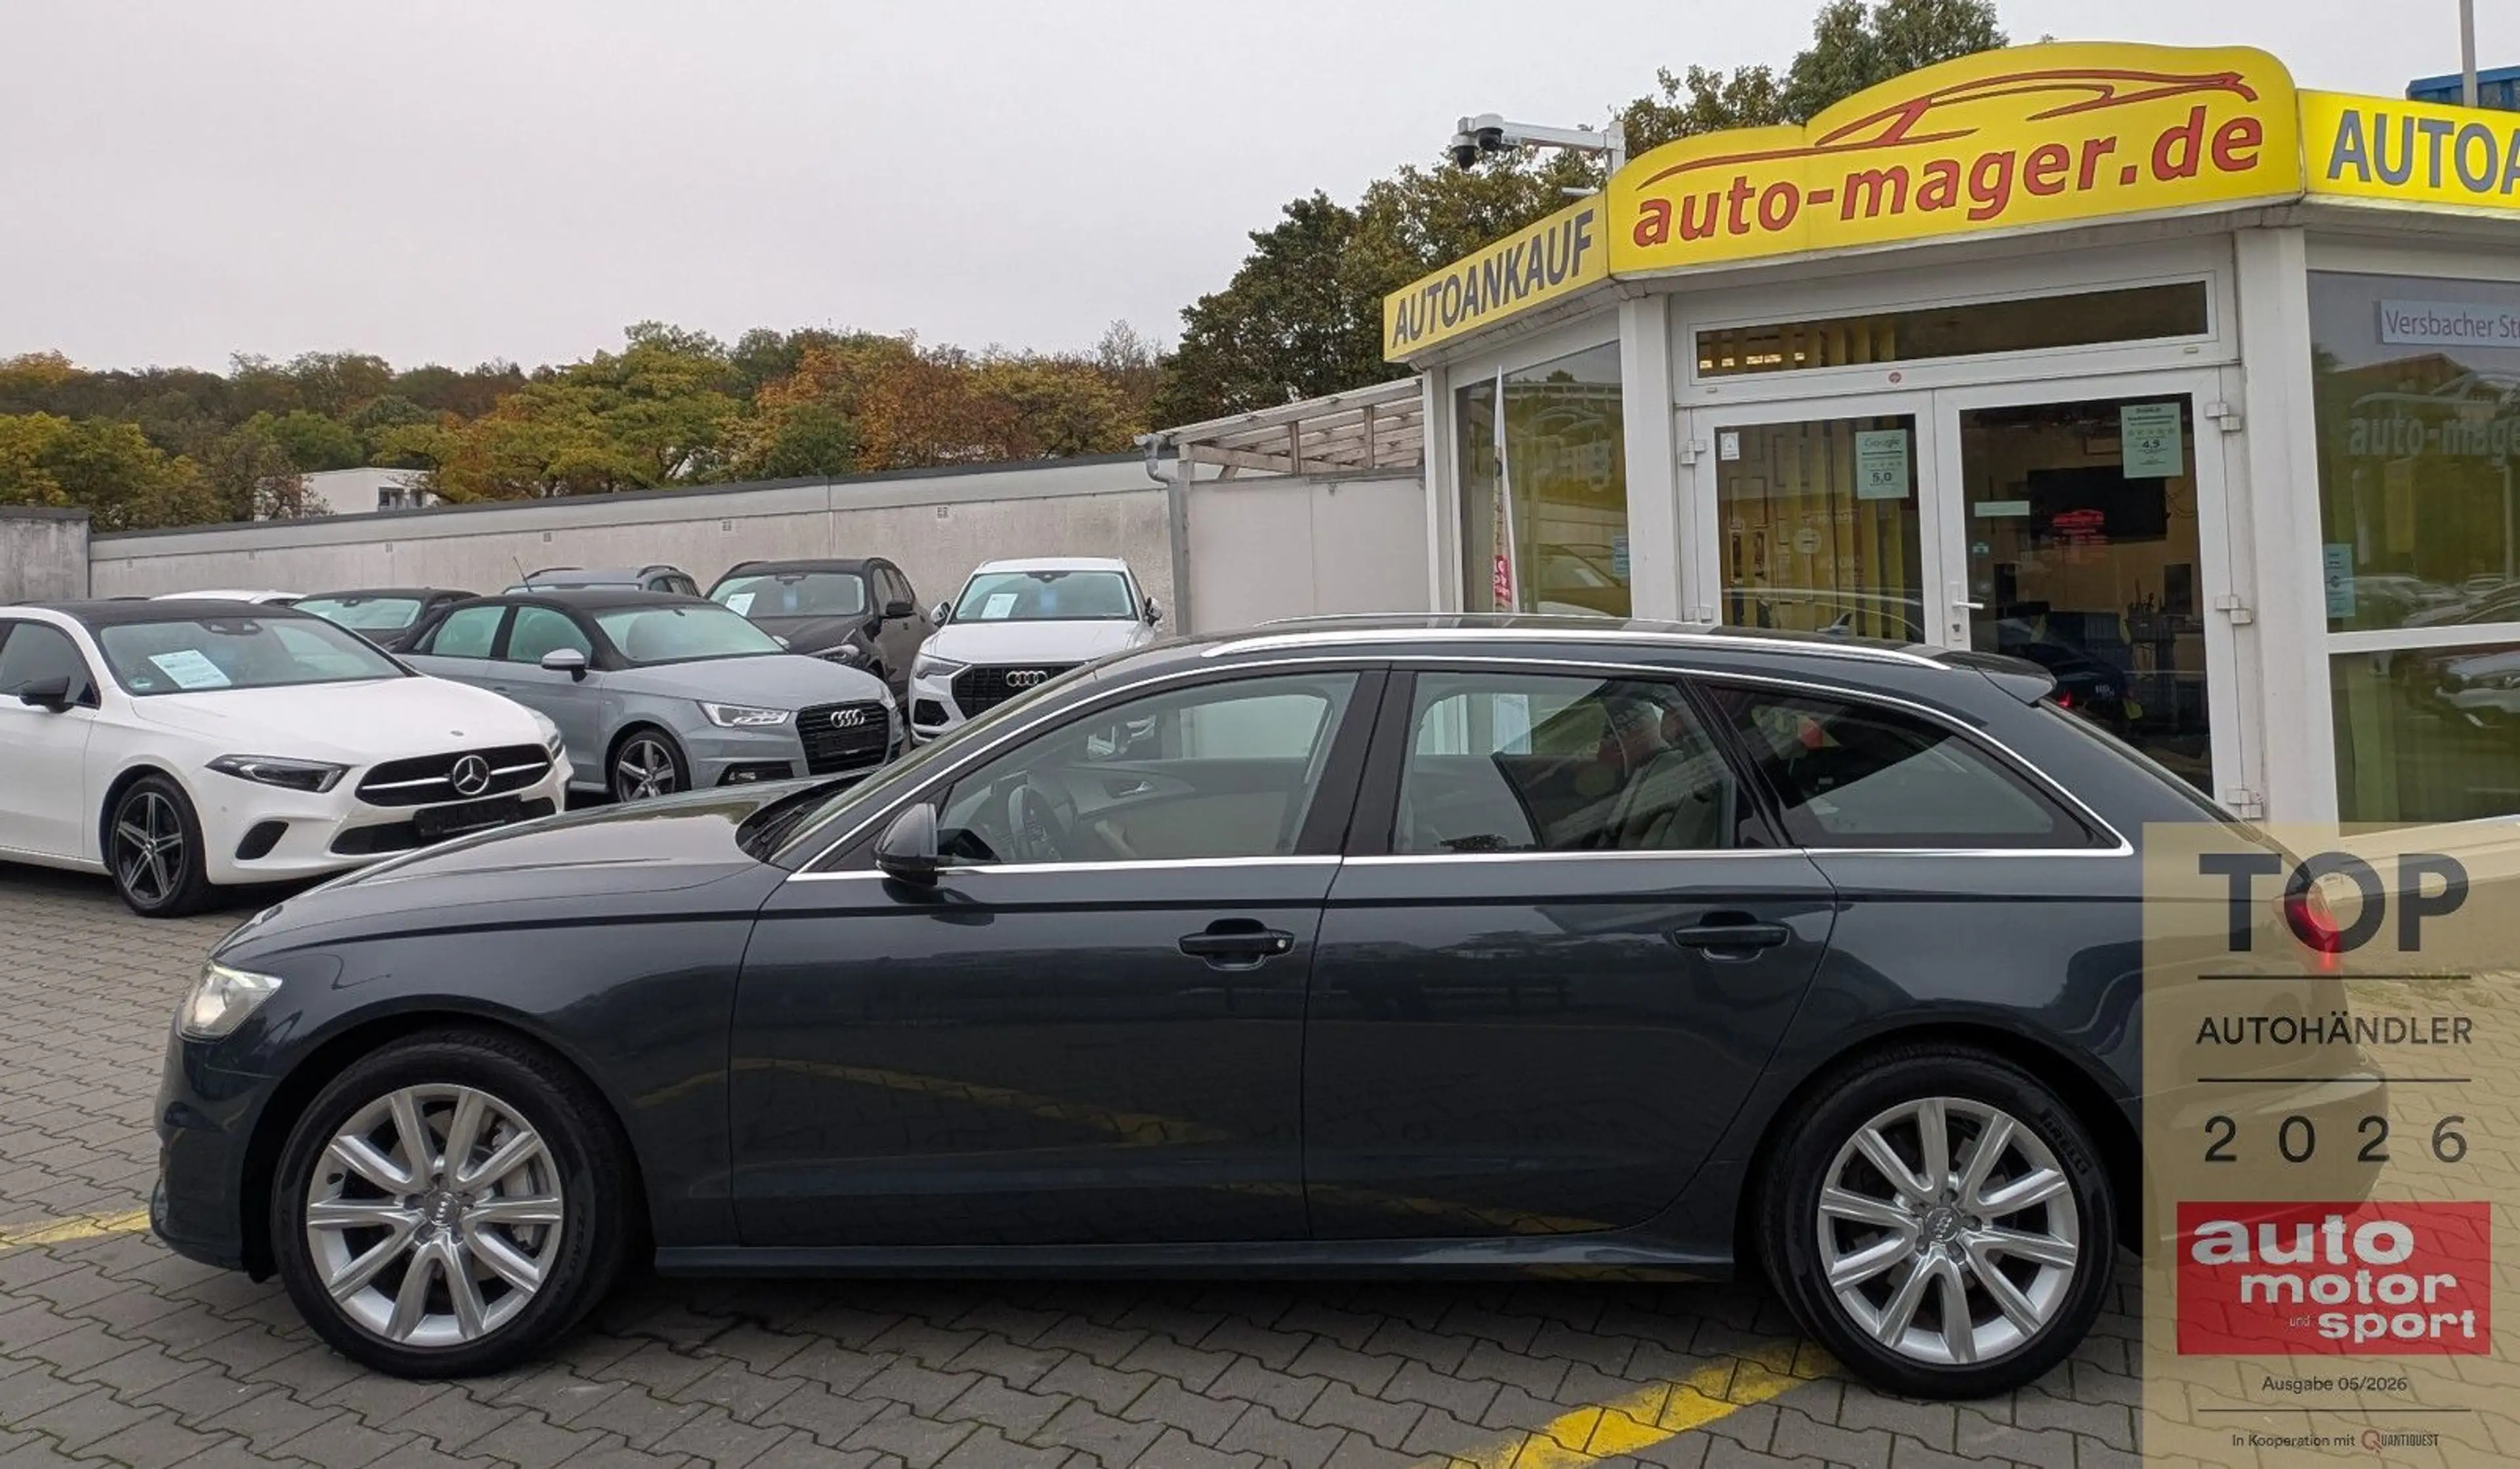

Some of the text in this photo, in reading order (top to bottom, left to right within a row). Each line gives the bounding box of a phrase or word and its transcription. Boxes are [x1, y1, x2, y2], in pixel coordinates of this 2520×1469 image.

[1633, 106, 2263, 247] auto-mager.de
[1392, 208, 1594, 348] AUTOANKAUF
[2385, 310, 2520, 339] Versbacher St
